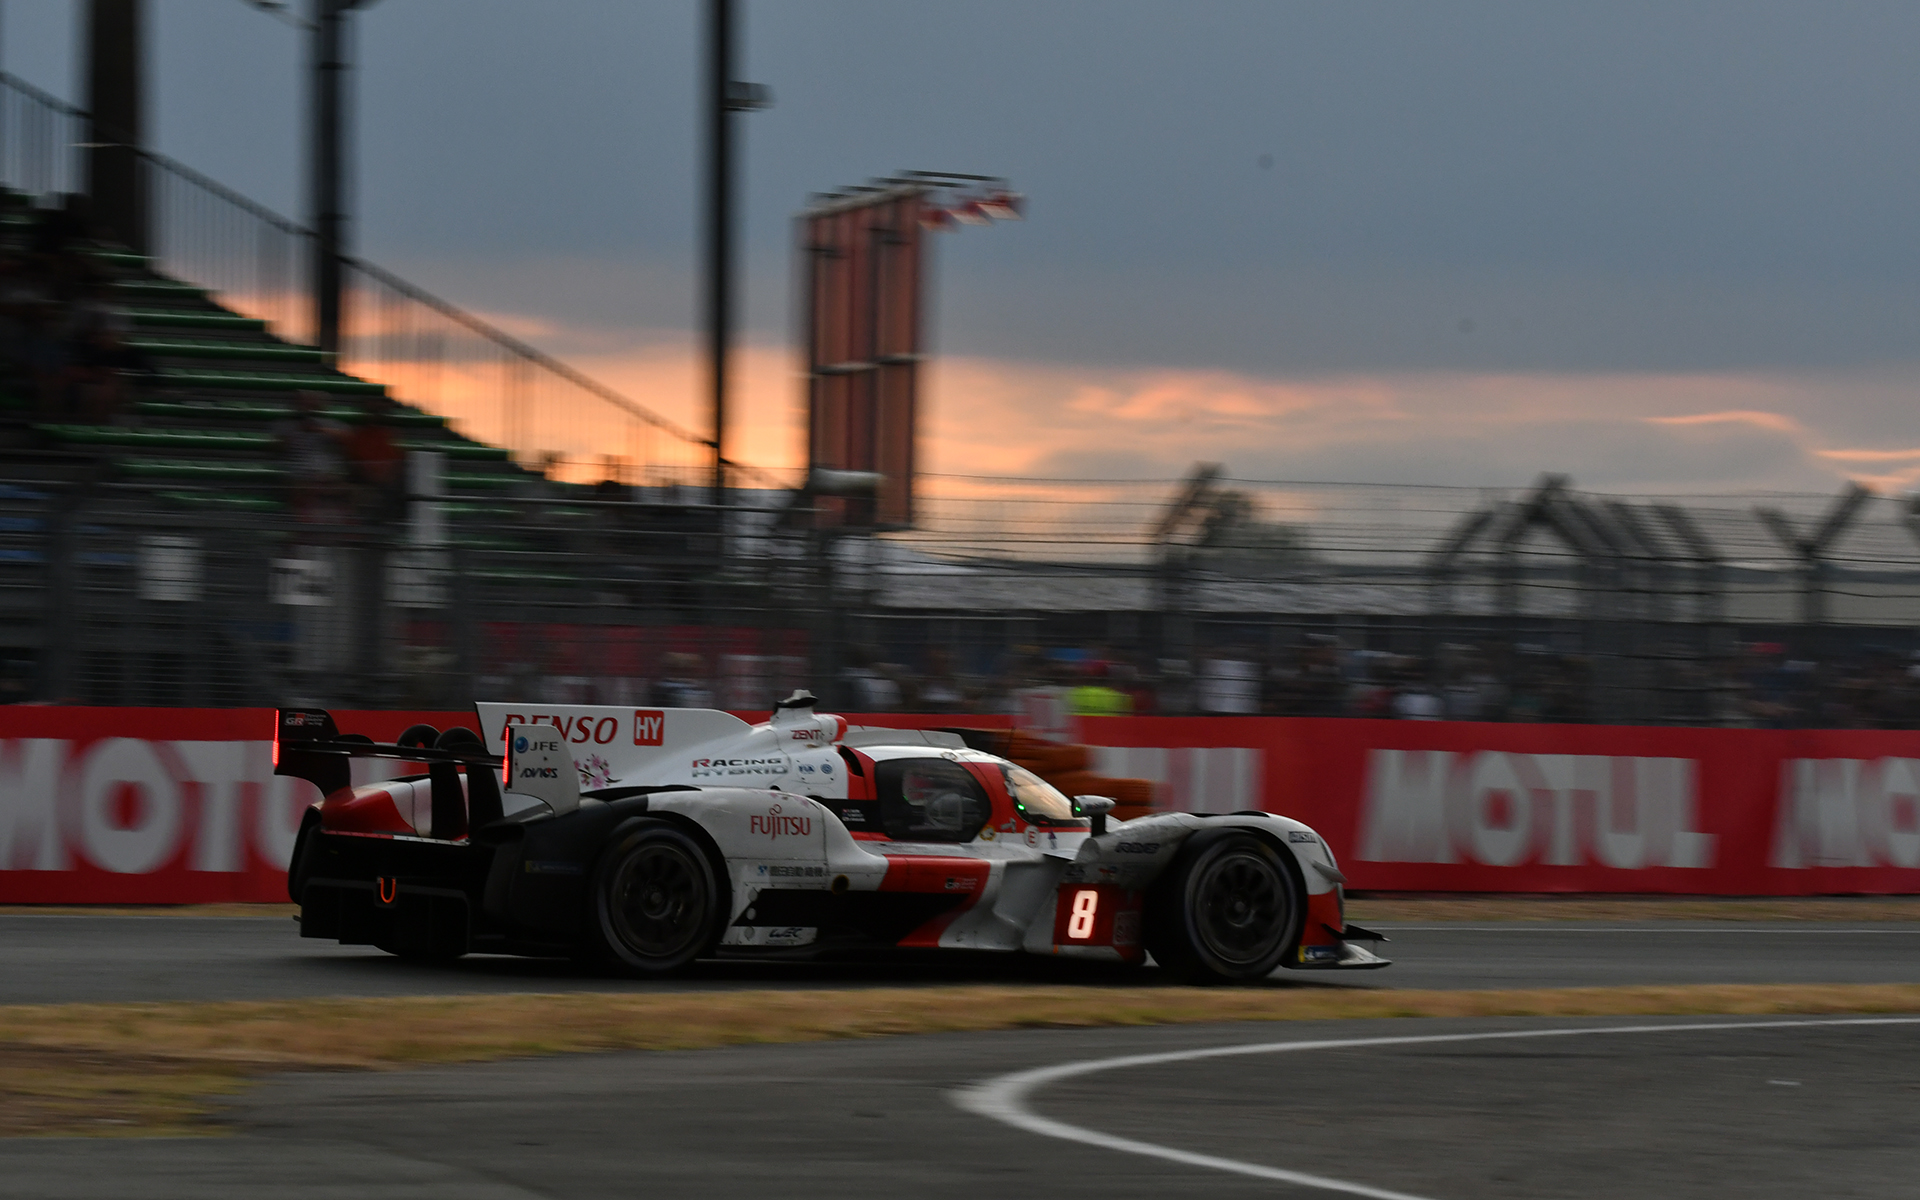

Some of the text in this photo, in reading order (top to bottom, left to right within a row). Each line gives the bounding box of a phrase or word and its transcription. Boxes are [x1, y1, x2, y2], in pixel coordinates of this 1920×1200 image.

[635, 715, 662, 740] HY
[790, 729, 822, 740] ZENT
[530, 741, 559, 752] JFE
[691, 766, 789, 778] HYBRID
[692, 758, 782, 768] RACING
[0, 737, 340, 873] MOTU
[1354, 749, 1719, 869] MOTUL
[750, 806, 811, 840] FUJITSU
[1028, 830, 1036, 844] E
[1067, 889, 1099, 940] 8
